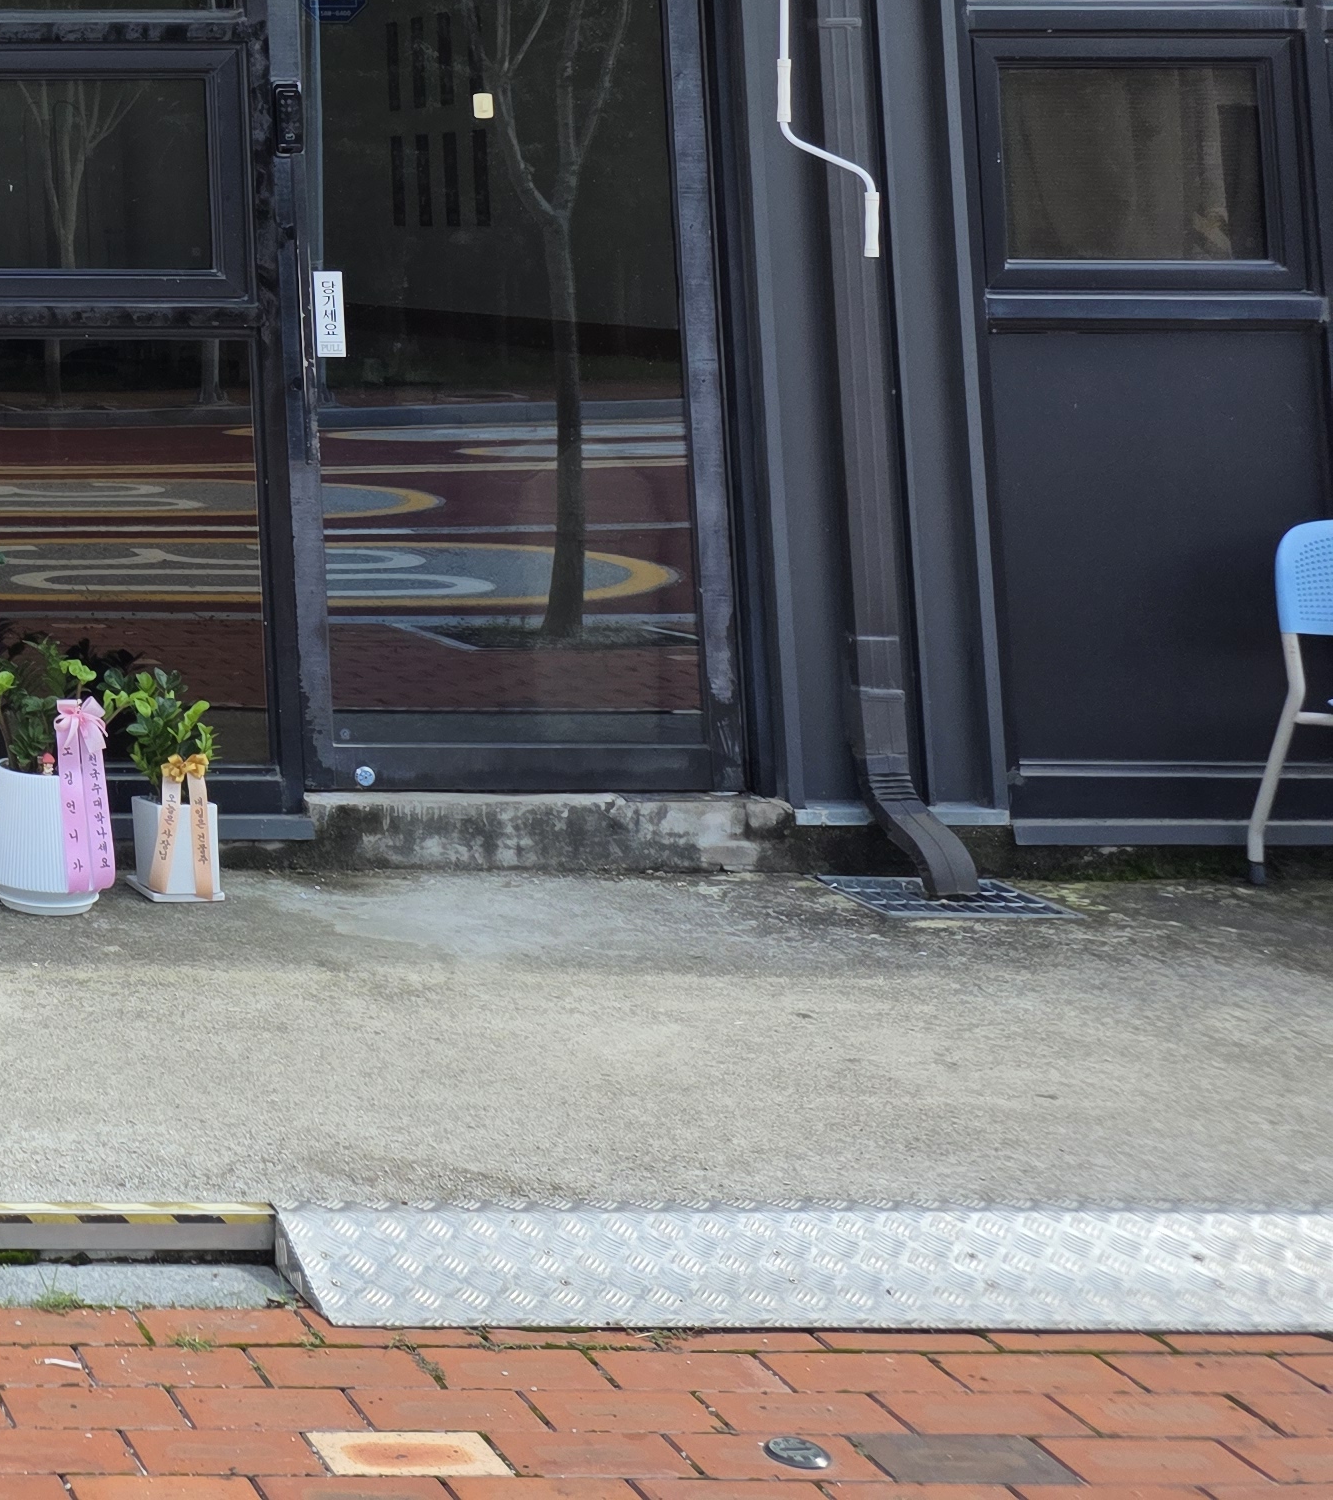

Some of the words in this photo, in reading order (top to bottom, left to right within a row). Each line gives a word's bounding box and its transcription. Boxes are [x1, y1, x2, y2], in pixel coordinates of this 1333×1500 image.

[321, 280, 338, 336] 당기세요
[321, 344, 343, 352] PULL
[164, 793, 176, 826] 오늘은
[194, 796, 206, 829] 내일은
[159, 828, 173, 861] 사장님
[197, 832, 208, 865] 건물주
